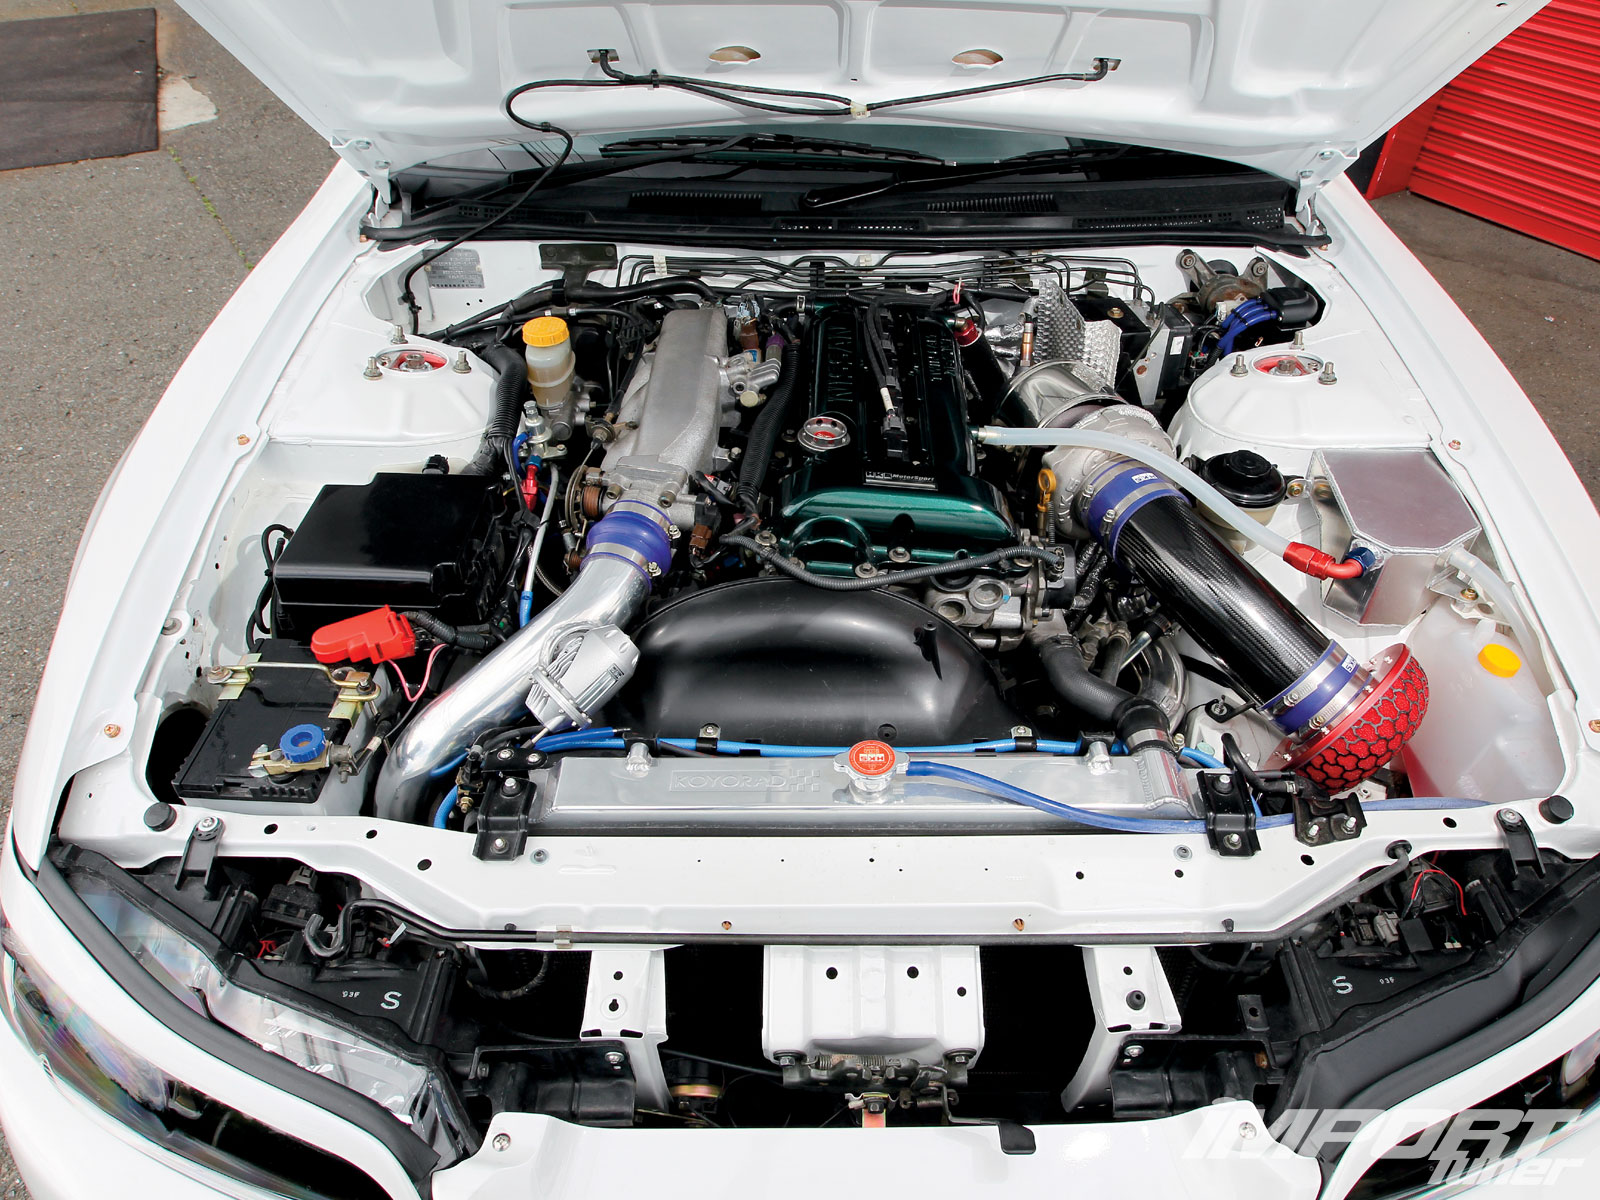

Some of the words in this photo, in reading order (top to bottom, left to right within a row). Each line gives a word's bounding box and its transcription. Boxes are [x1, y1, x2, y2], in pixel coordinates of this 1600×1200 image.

[828, 325, 853, 402] NISSAN
[674, 774, 787, 788] KOYORAD
[1332, 975, 1354, 994] S
[380, 990, 402, 1010] S
